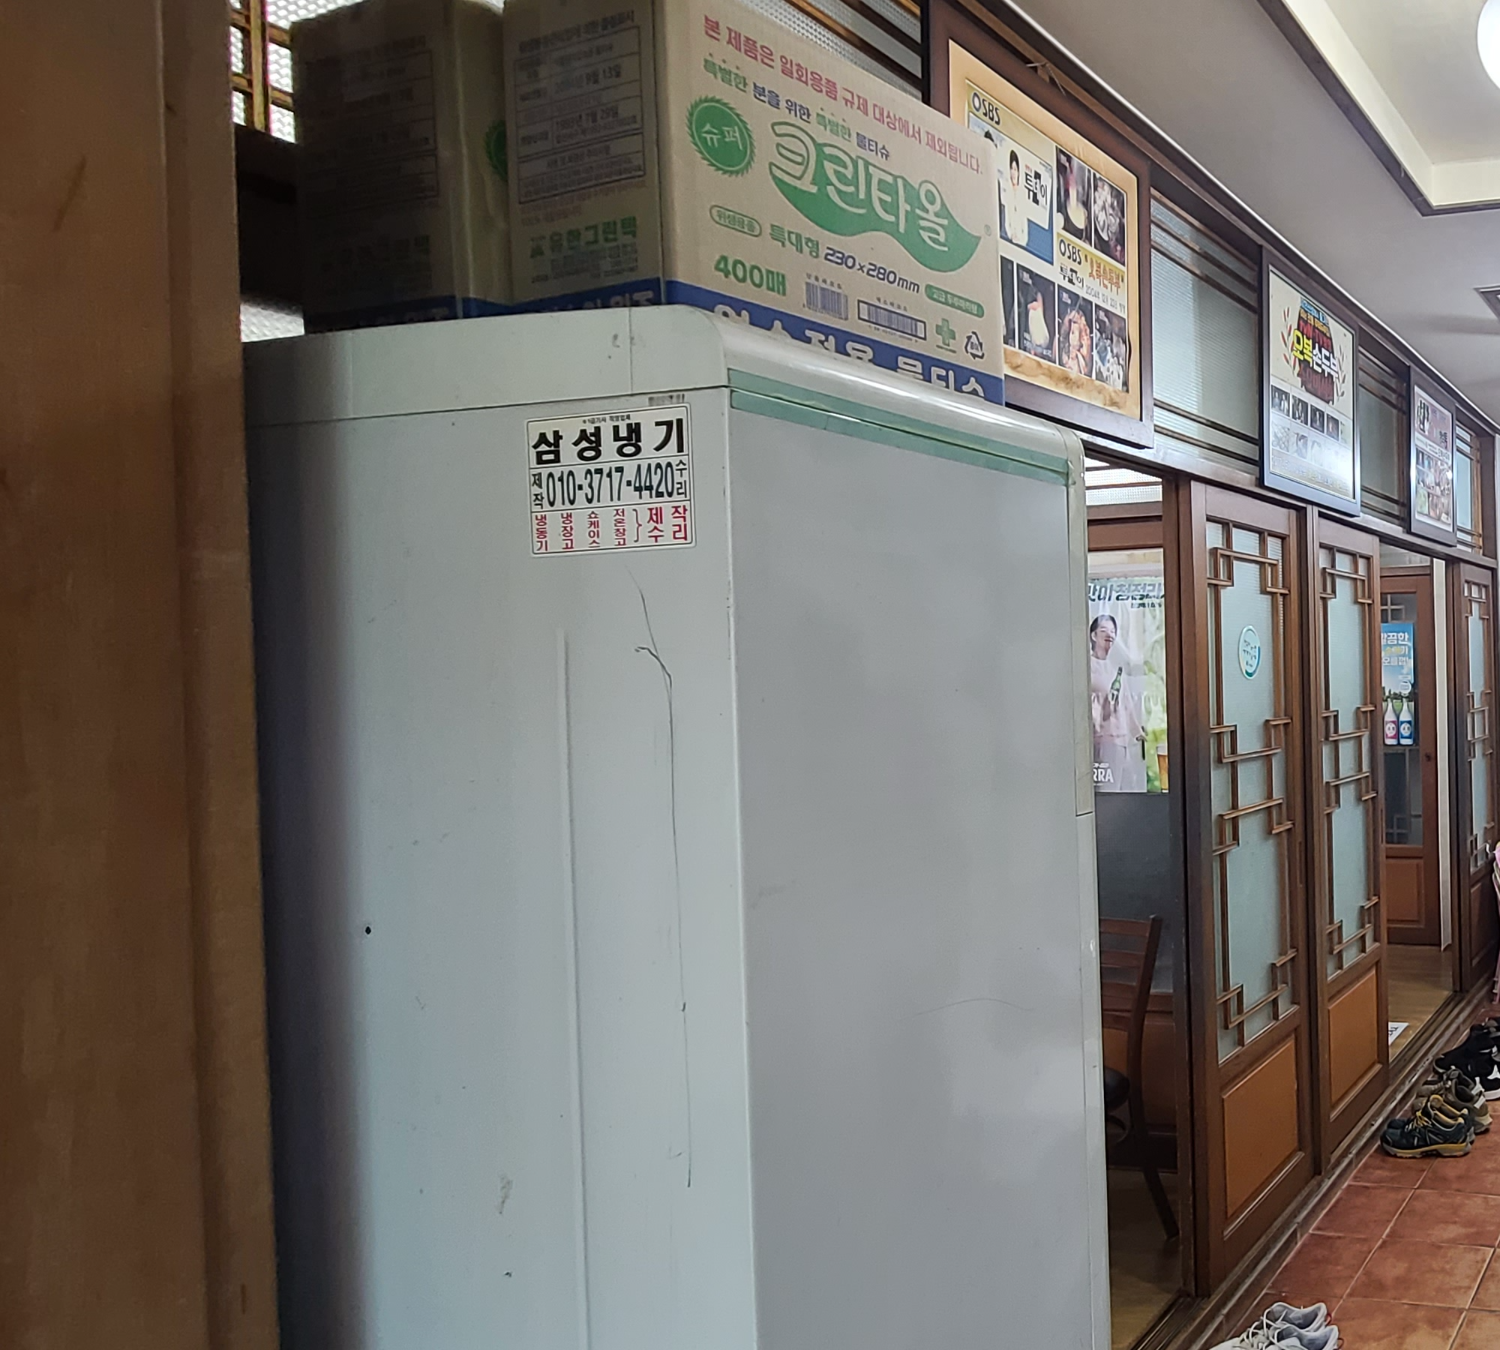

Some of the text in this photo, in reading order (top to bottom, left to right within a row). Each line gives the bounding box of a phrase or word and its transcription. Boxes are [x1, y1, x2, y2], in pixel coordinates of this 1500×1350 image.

[704, 14, 721, 42] 본
[726, 26, 775, 69] 제품은
[779, 55, 838, 101] 일회용품
[842, 87, 869, 117] 규제
[873, 103, 922, 146] 대상에서
[703, 57, 749, 93] 특별한
[753, 82, 781, 110] 분을
[785, 98, 811, 125] 위한
[855, 131, 890, 160] 물티슈
[701, 125, 743, 152] 슈퍼
[769, 121, 950, 253] 크린타올
[770, 223, 819, 260] 특대형
[714, 254, 787, 297] 400매
[532, 418, 685, 466] 삼성냉기
[532, 472, 545, 510] 제작
[546, 461, 675, 508] 010-3717-4420
[675, 459, 688, 499] 수리
[561, 512, 575, 550] 냉장고
[587, 511, 601, 548] 쇼케이스
